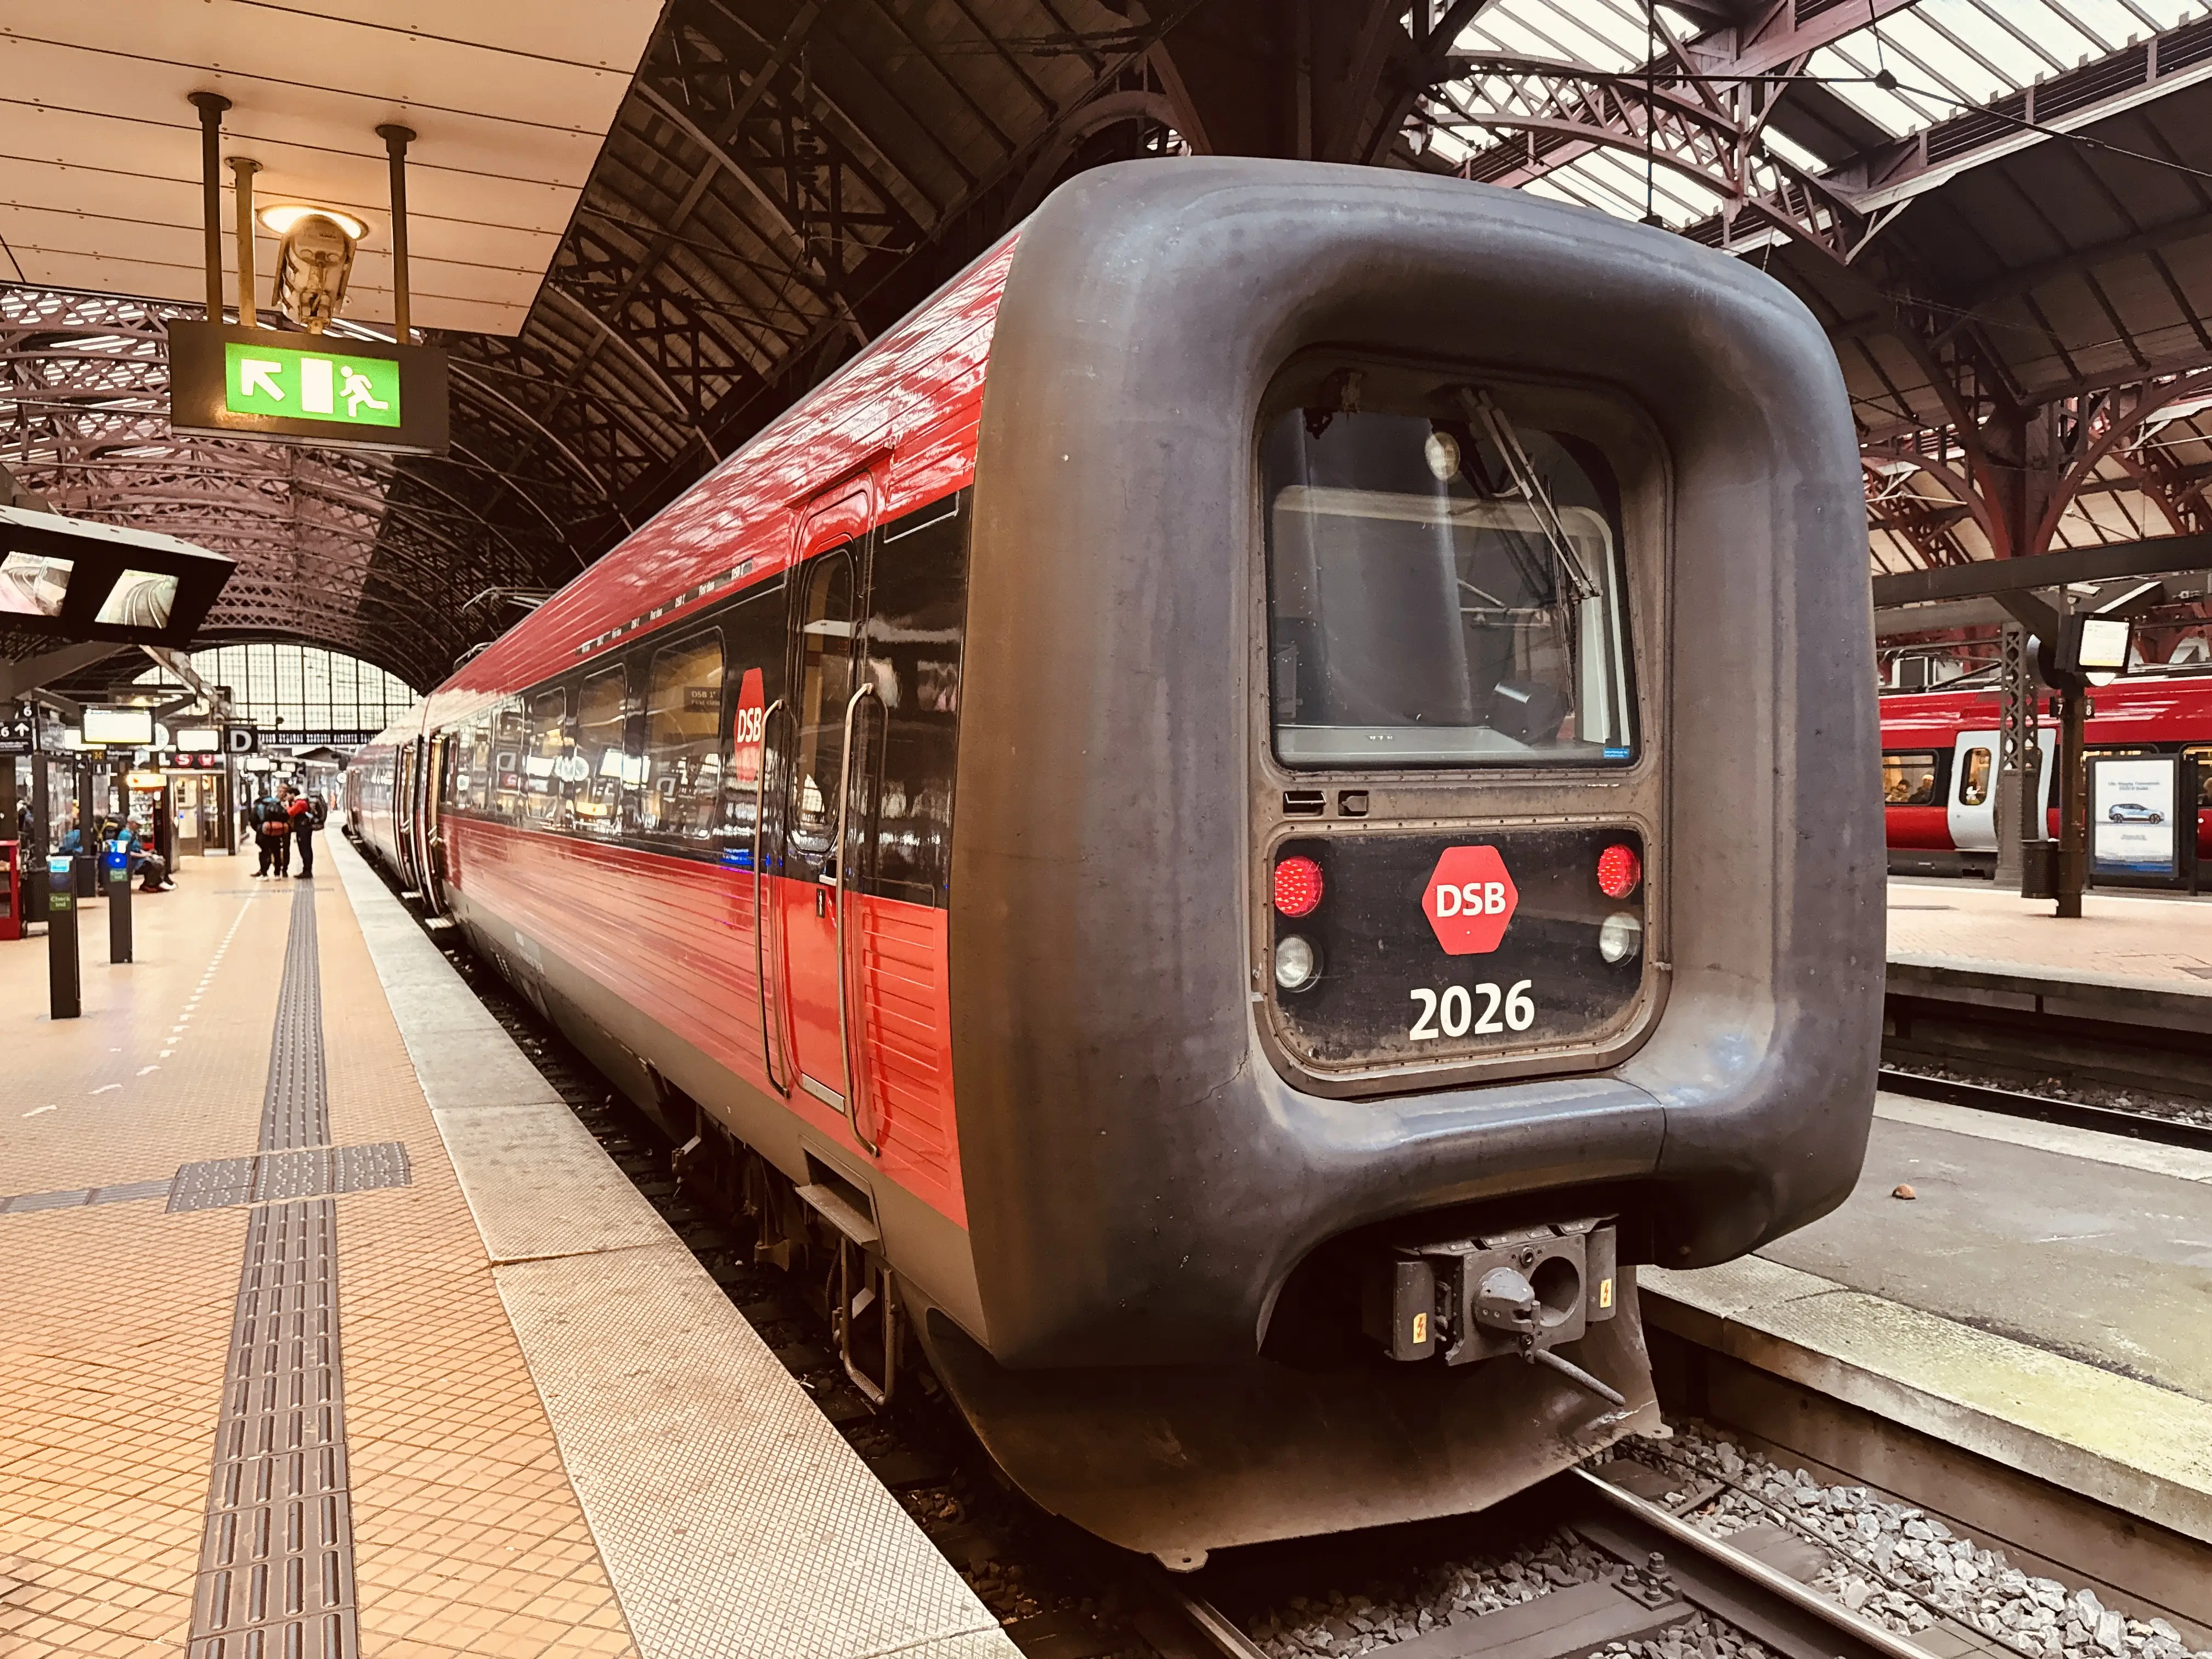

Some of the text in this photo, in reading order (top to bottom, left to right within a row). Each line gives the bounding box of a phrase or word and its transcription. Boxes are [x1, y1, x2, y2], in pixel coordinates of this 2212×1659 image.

[23, 706, 32, 717] 6
[2086, 704, 2091, 716] 8
[737, 707, 762, 743] DSB
[230, 729, 252, 752] D
[1436, 882, 1506, 918] DSB
[1409, 979, 1535, 1041] 2026
